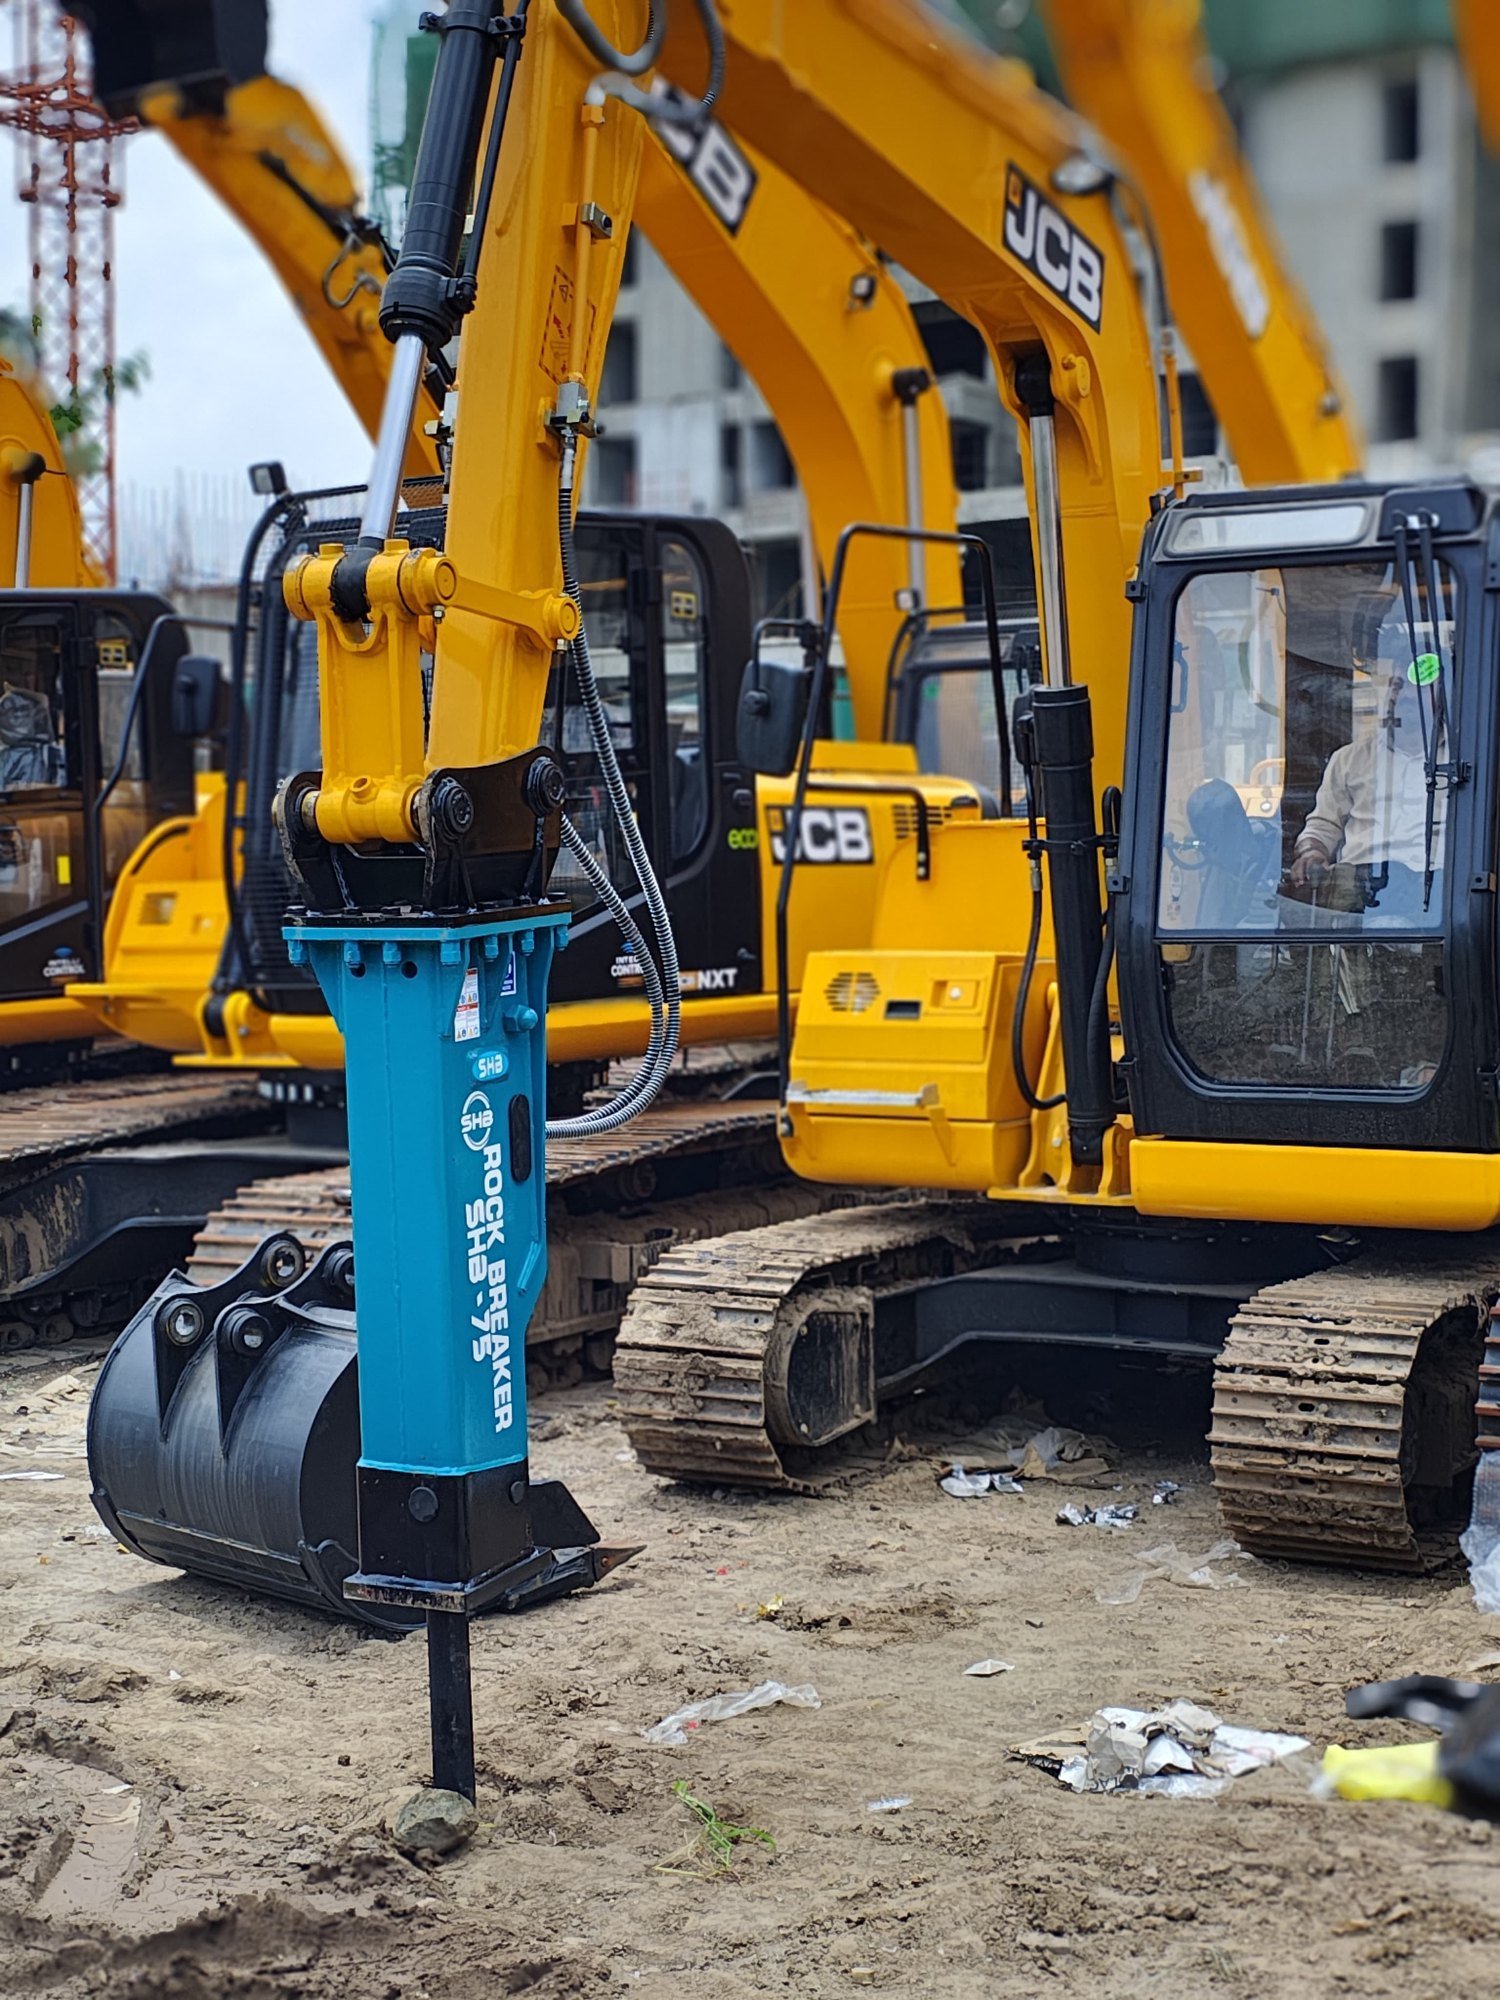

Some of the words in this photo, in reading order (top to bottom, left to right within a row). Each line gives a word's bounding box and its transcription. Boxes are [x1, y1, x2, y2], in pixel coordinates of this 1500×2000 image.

[1005, 188, 1101, 322] JCB
[478, 1054, 503, 1079] SHB
[461, 1109, 493, 1133] SHB
[483, 1143, 505, 1251] ROCK
[487, 1258, 513, 1434] BREAKER
